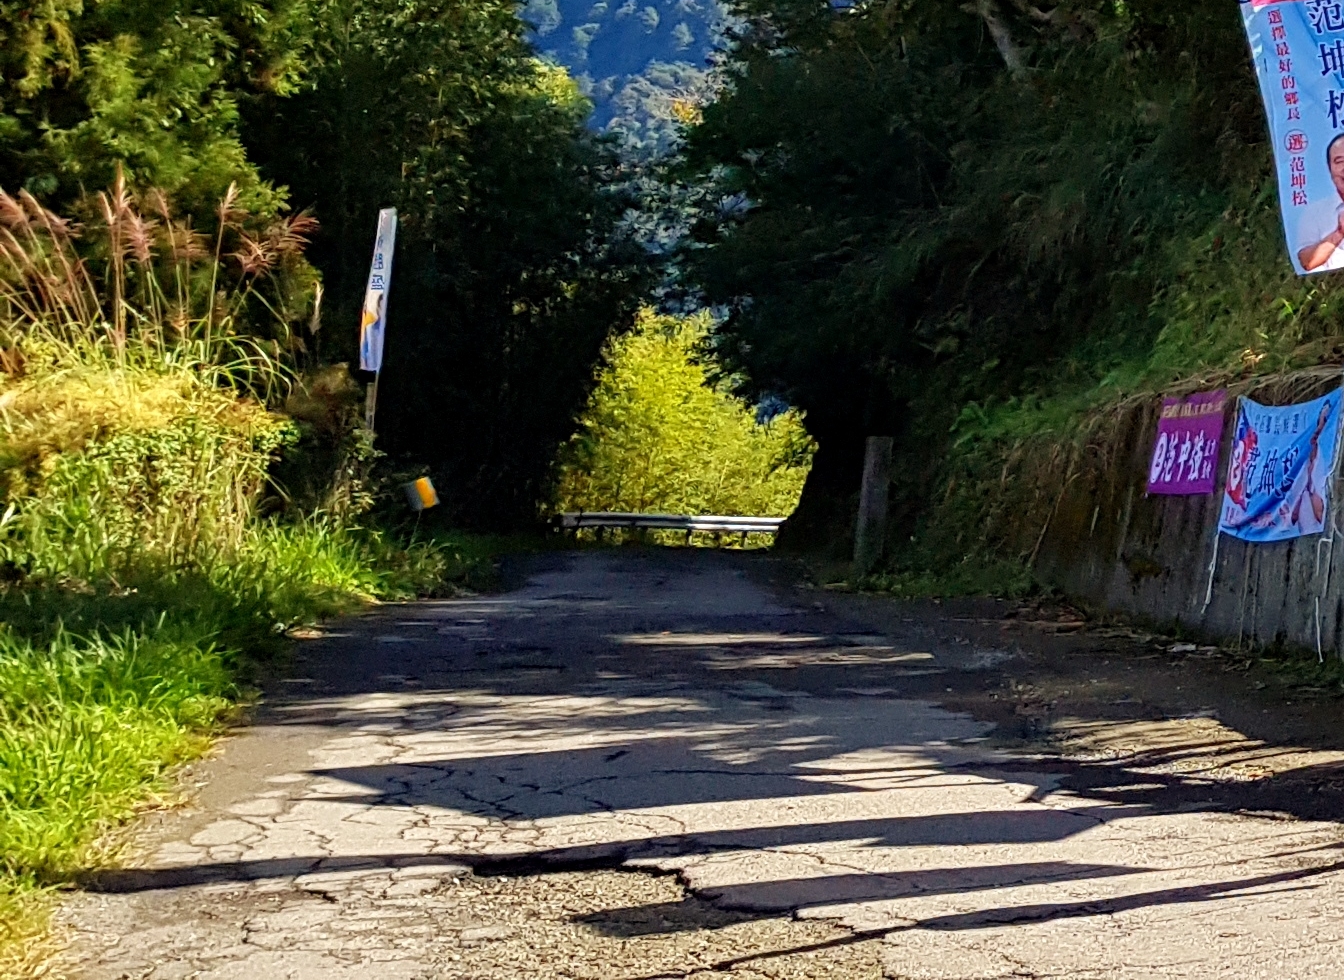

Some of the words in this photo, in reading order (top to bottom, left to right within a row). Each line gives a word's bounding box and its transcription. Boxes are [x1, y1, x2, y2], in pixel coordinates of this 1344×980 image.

[1267, 9, 1302, 121] 選擇最好的鄉長
[1289, 156, 1309, 207] 范坤松
